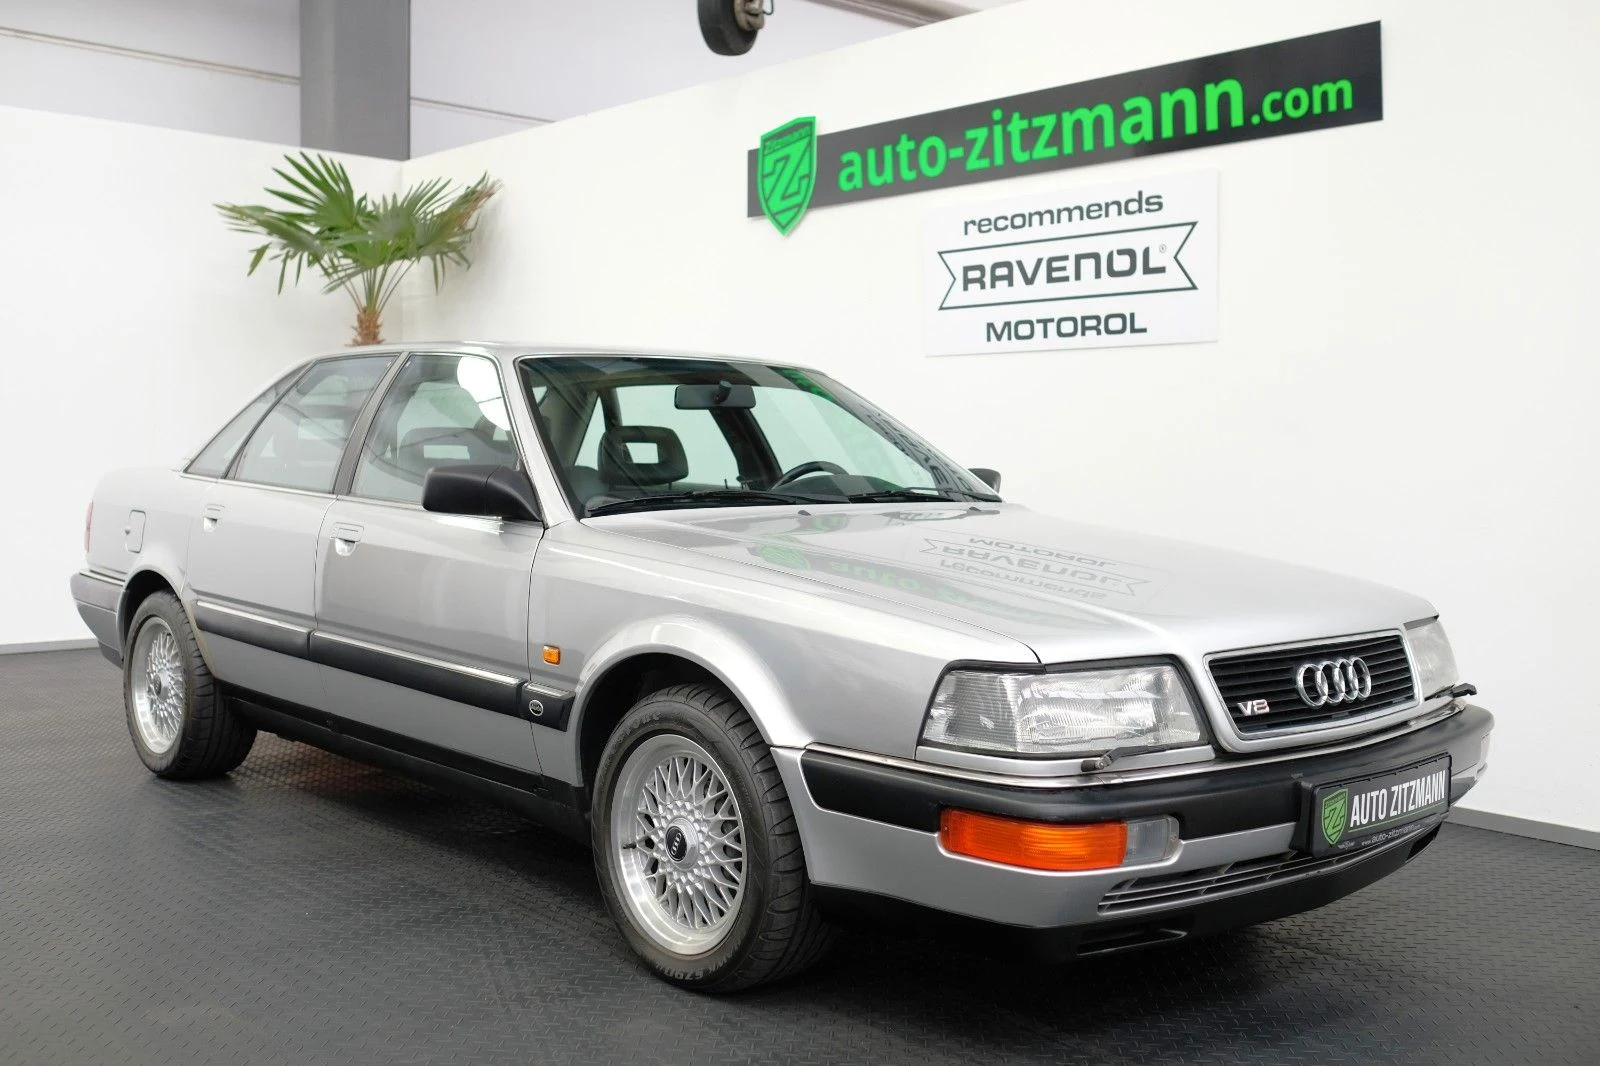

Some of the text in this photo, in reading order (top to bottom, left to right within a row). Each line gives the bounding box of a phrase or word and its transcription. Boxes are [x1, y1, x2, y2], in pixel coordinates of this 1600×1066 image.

[838, 79, 1354, 192] auto-zitzmann.com
[963, 190, 1164, 236] recommends
[986, 312, 1148, 342] MOTOROL
[1237, 699, 1270, 716] V8
[1349, 769, 1446, 828] AUTO ZITZMANN
